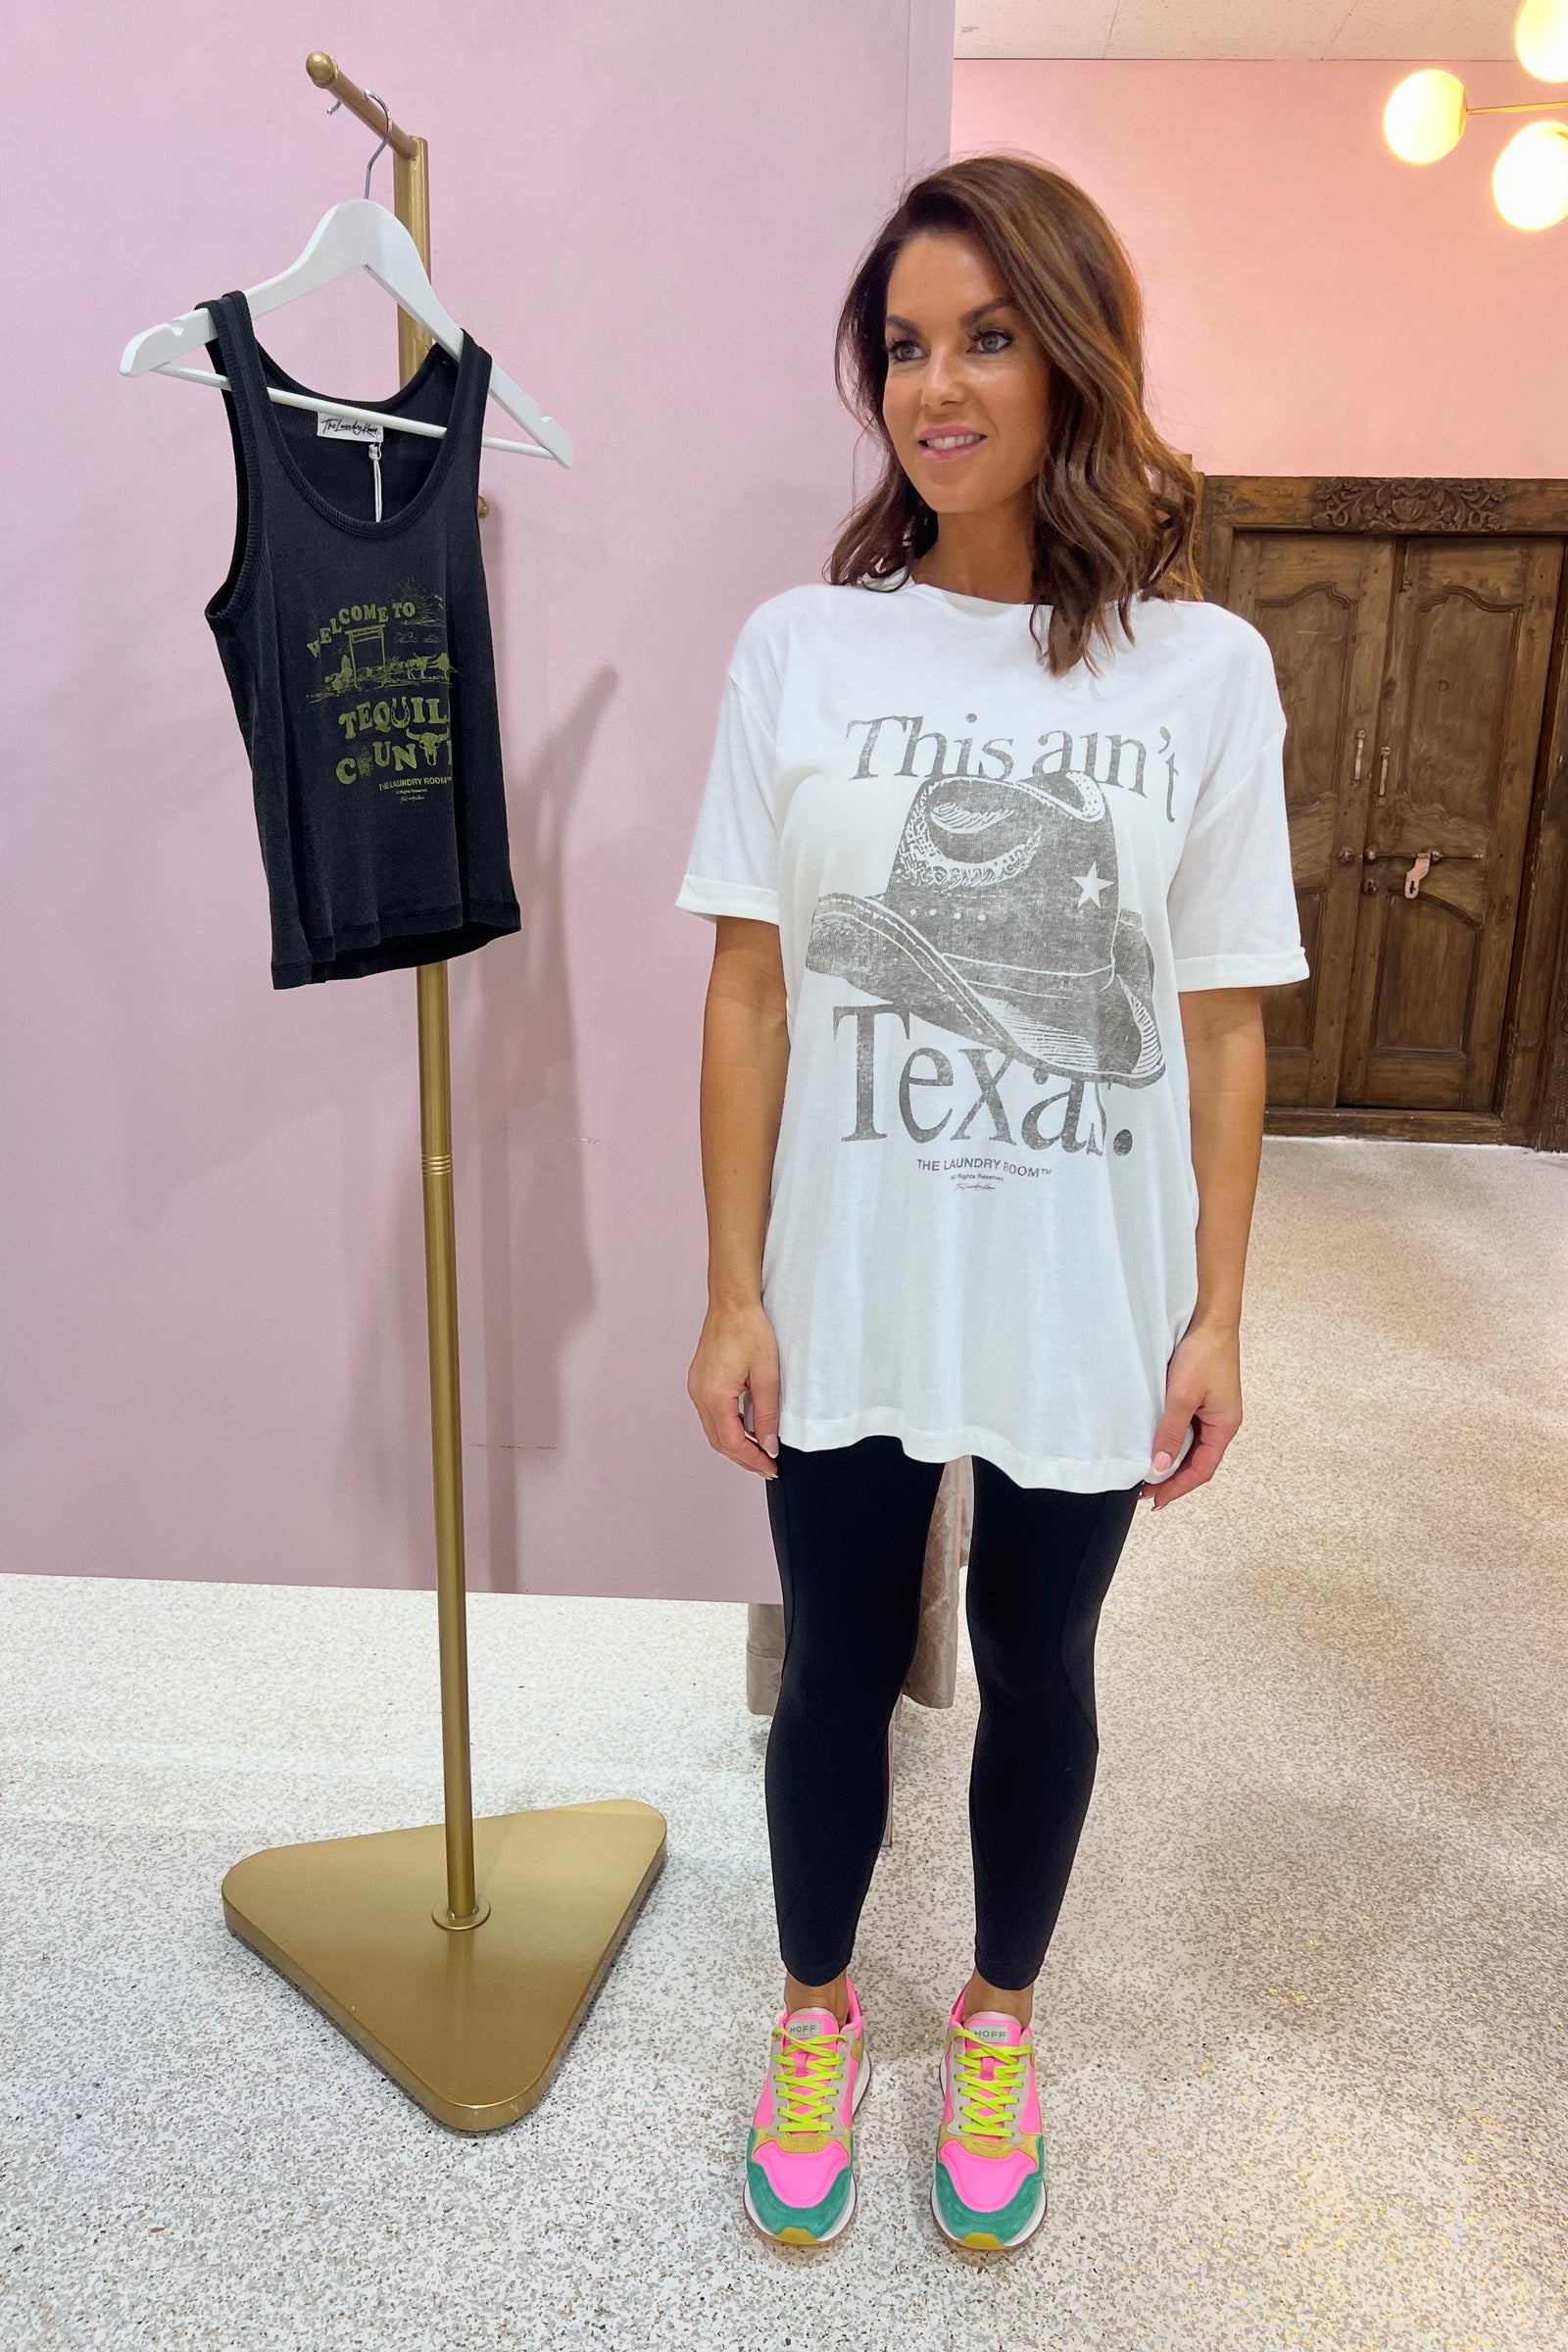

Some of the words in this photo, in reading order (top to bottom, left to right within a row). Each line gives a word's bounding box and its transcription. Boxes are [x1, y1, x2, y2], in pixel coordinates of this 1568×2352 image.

[307, 604, 389, 658] WELCOME
[392, 602, 416, 618] TO
[338, 696, 450, 740] TEQUIL
[846, 712, 1014, 781] This
[1032, 726, 1179, 823] ain't
[390, 777, 422, 788] LAUNDRY
[917, 1158, 940, 1171] THE
[943, 1157, 1002, 1170] LAUNDRY
[790, 2025, 816, 2034] HOFF
[974, 2029, 1006, 2038] HOFF
